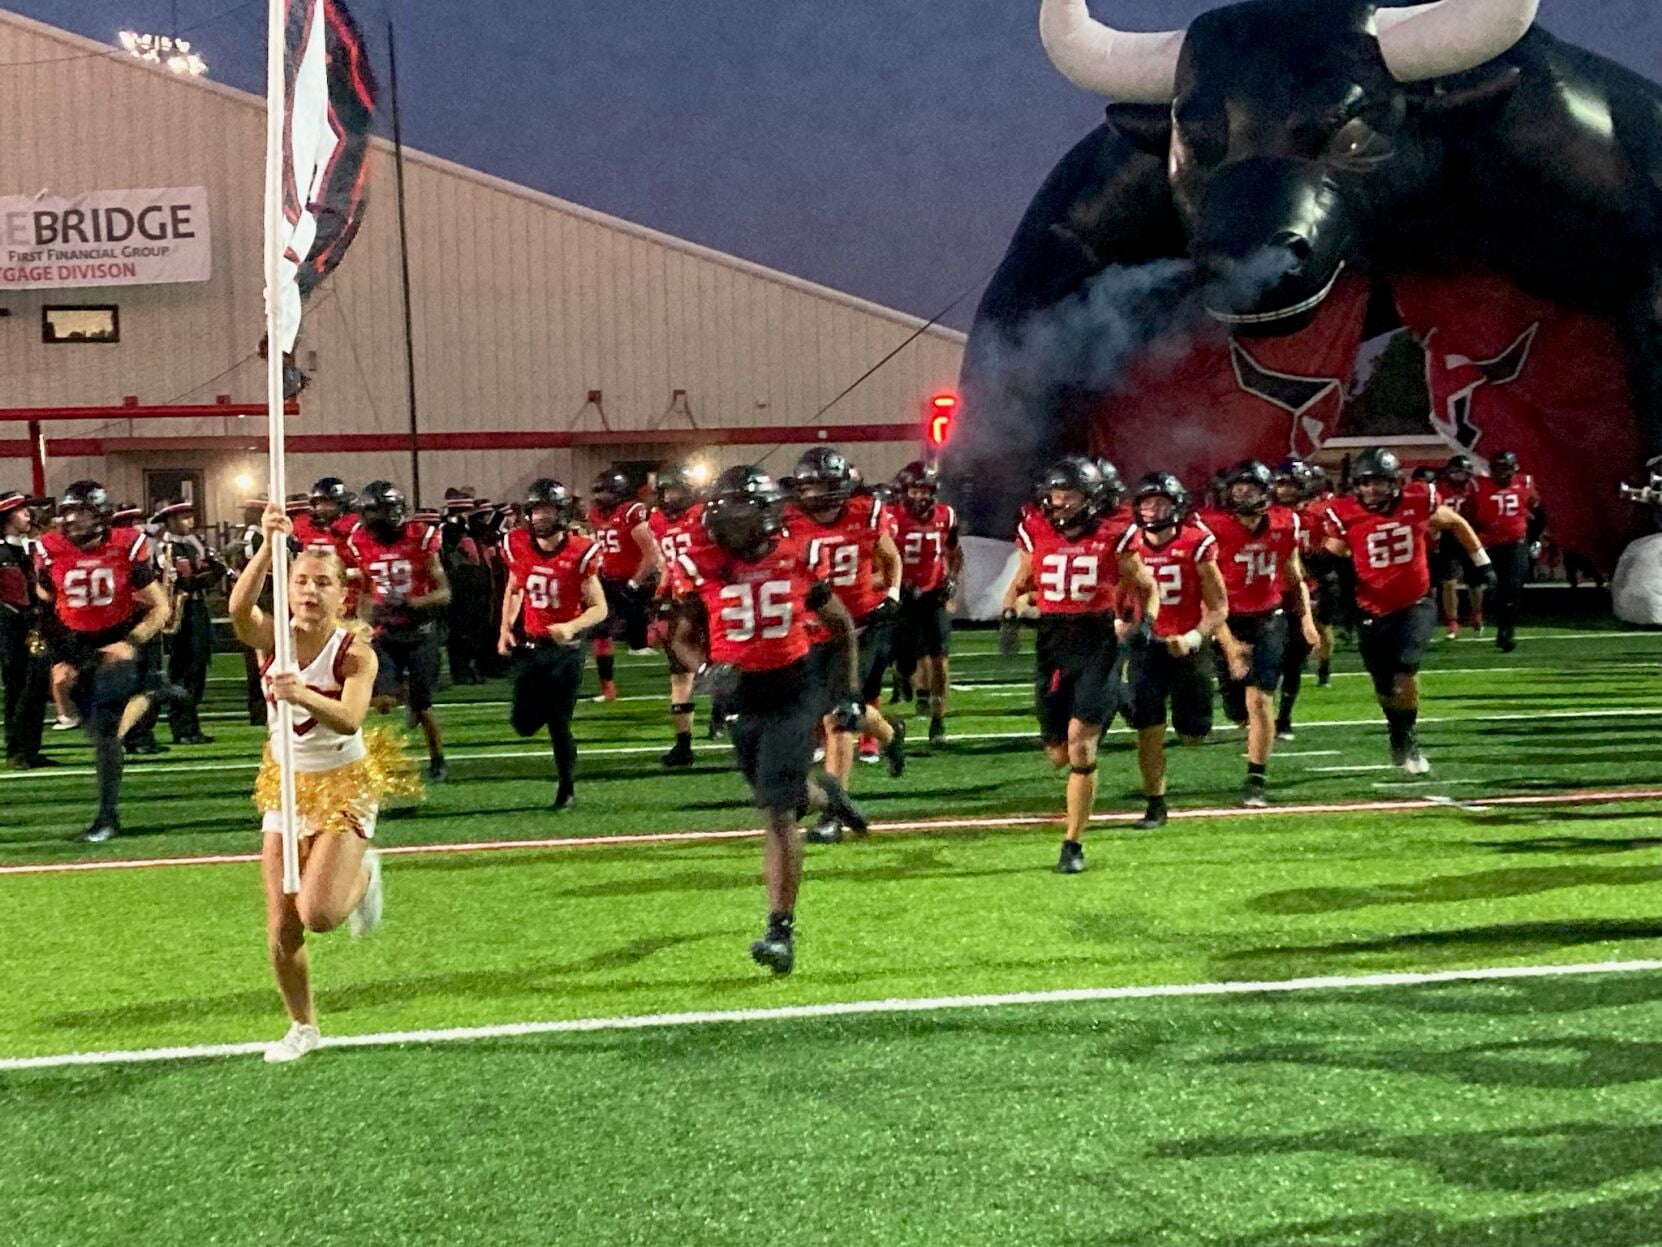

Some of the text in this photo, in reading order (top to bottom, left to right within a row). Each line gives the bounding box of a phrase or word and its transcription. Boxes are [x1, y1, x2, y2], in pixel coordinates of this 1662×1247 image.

[8, 246, 170, 262] FIRST FINANCIAL GROUP
[57, 263, 136, 280] DIVISON
[904, 532, 942, 565] 27
[1367, 525, 1415, 568] 63
[1040, 554, 1099, 602] 32
[1145, 564, 1182, 606] 2
[1234, 550, 1278, 585] 74
[64, 568, 114, 608] 50
[720, 580, 793, 643] 35
